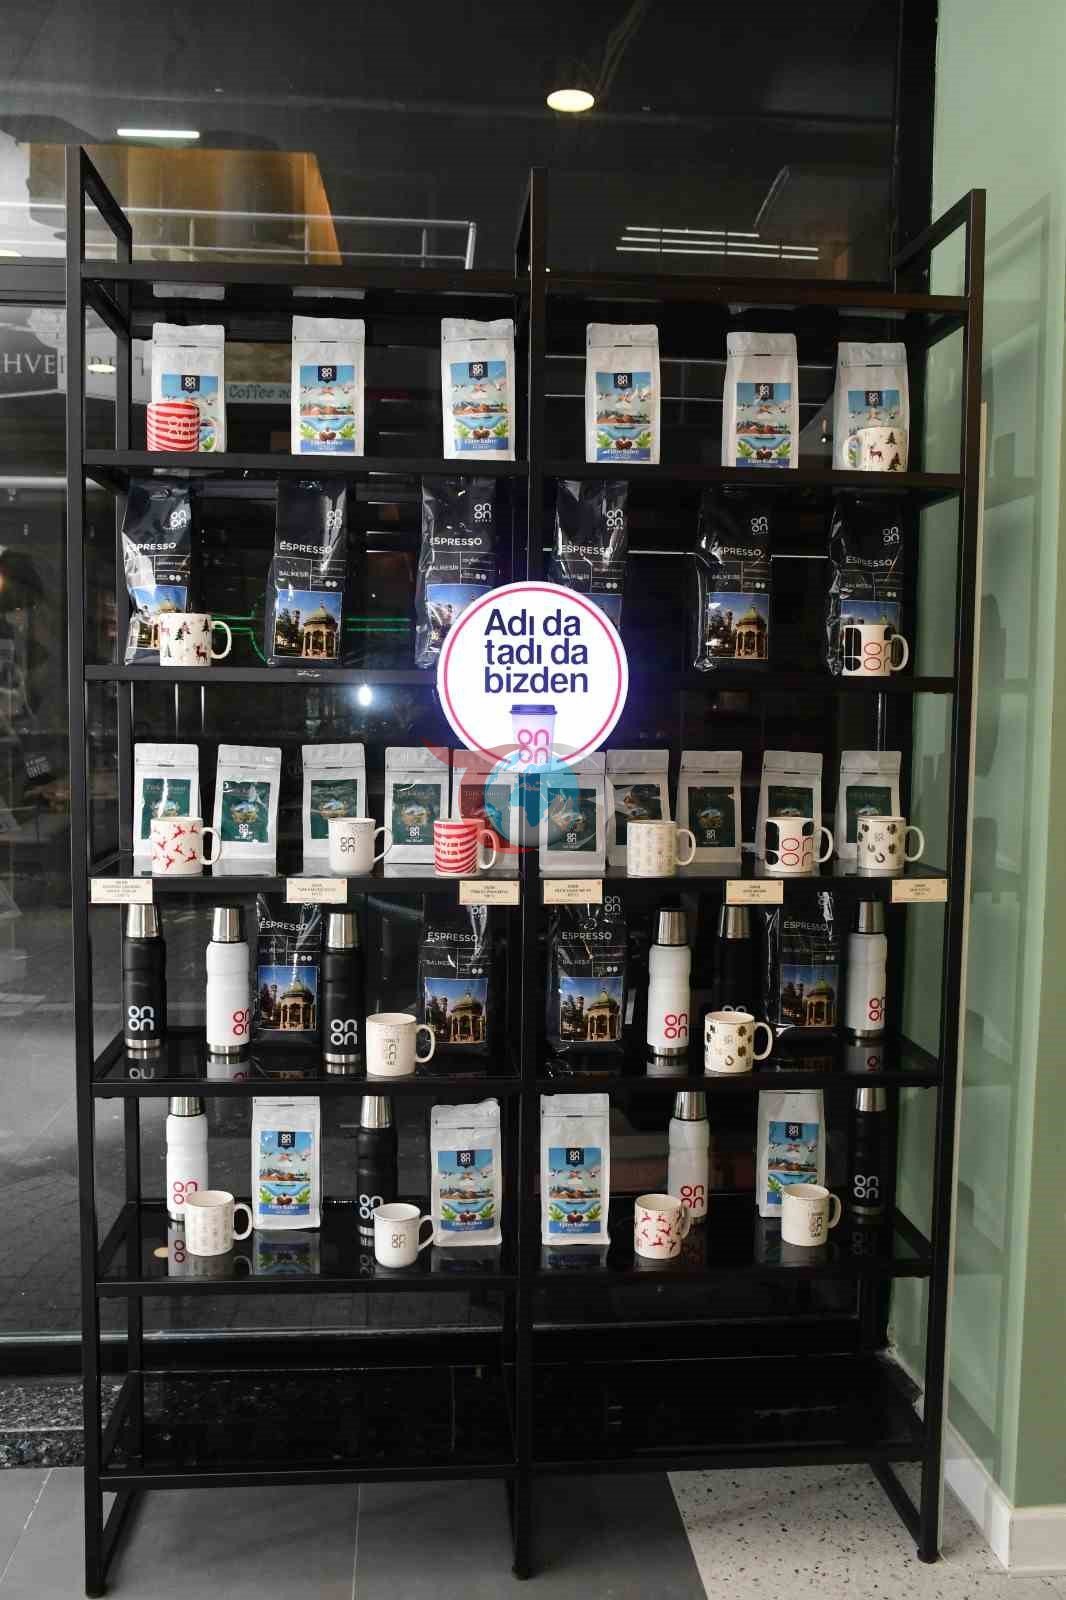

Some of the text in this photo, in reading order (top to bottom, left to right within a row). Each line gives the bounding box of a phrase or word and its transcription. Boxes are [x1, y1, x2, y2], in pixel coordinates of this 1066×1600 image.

[279, 541, 333, 554] ESPRESSO
[484, 609, 581, 636] Adı da
[484, 638, 588, 665] tadı da
[484, 667, 588, 693] bizden
[260, 918, 309, 931] ESPRESSO
[427, 932, 478, 943] ESPRESSO
[562, 931, 612, 940] ESPRESSO
